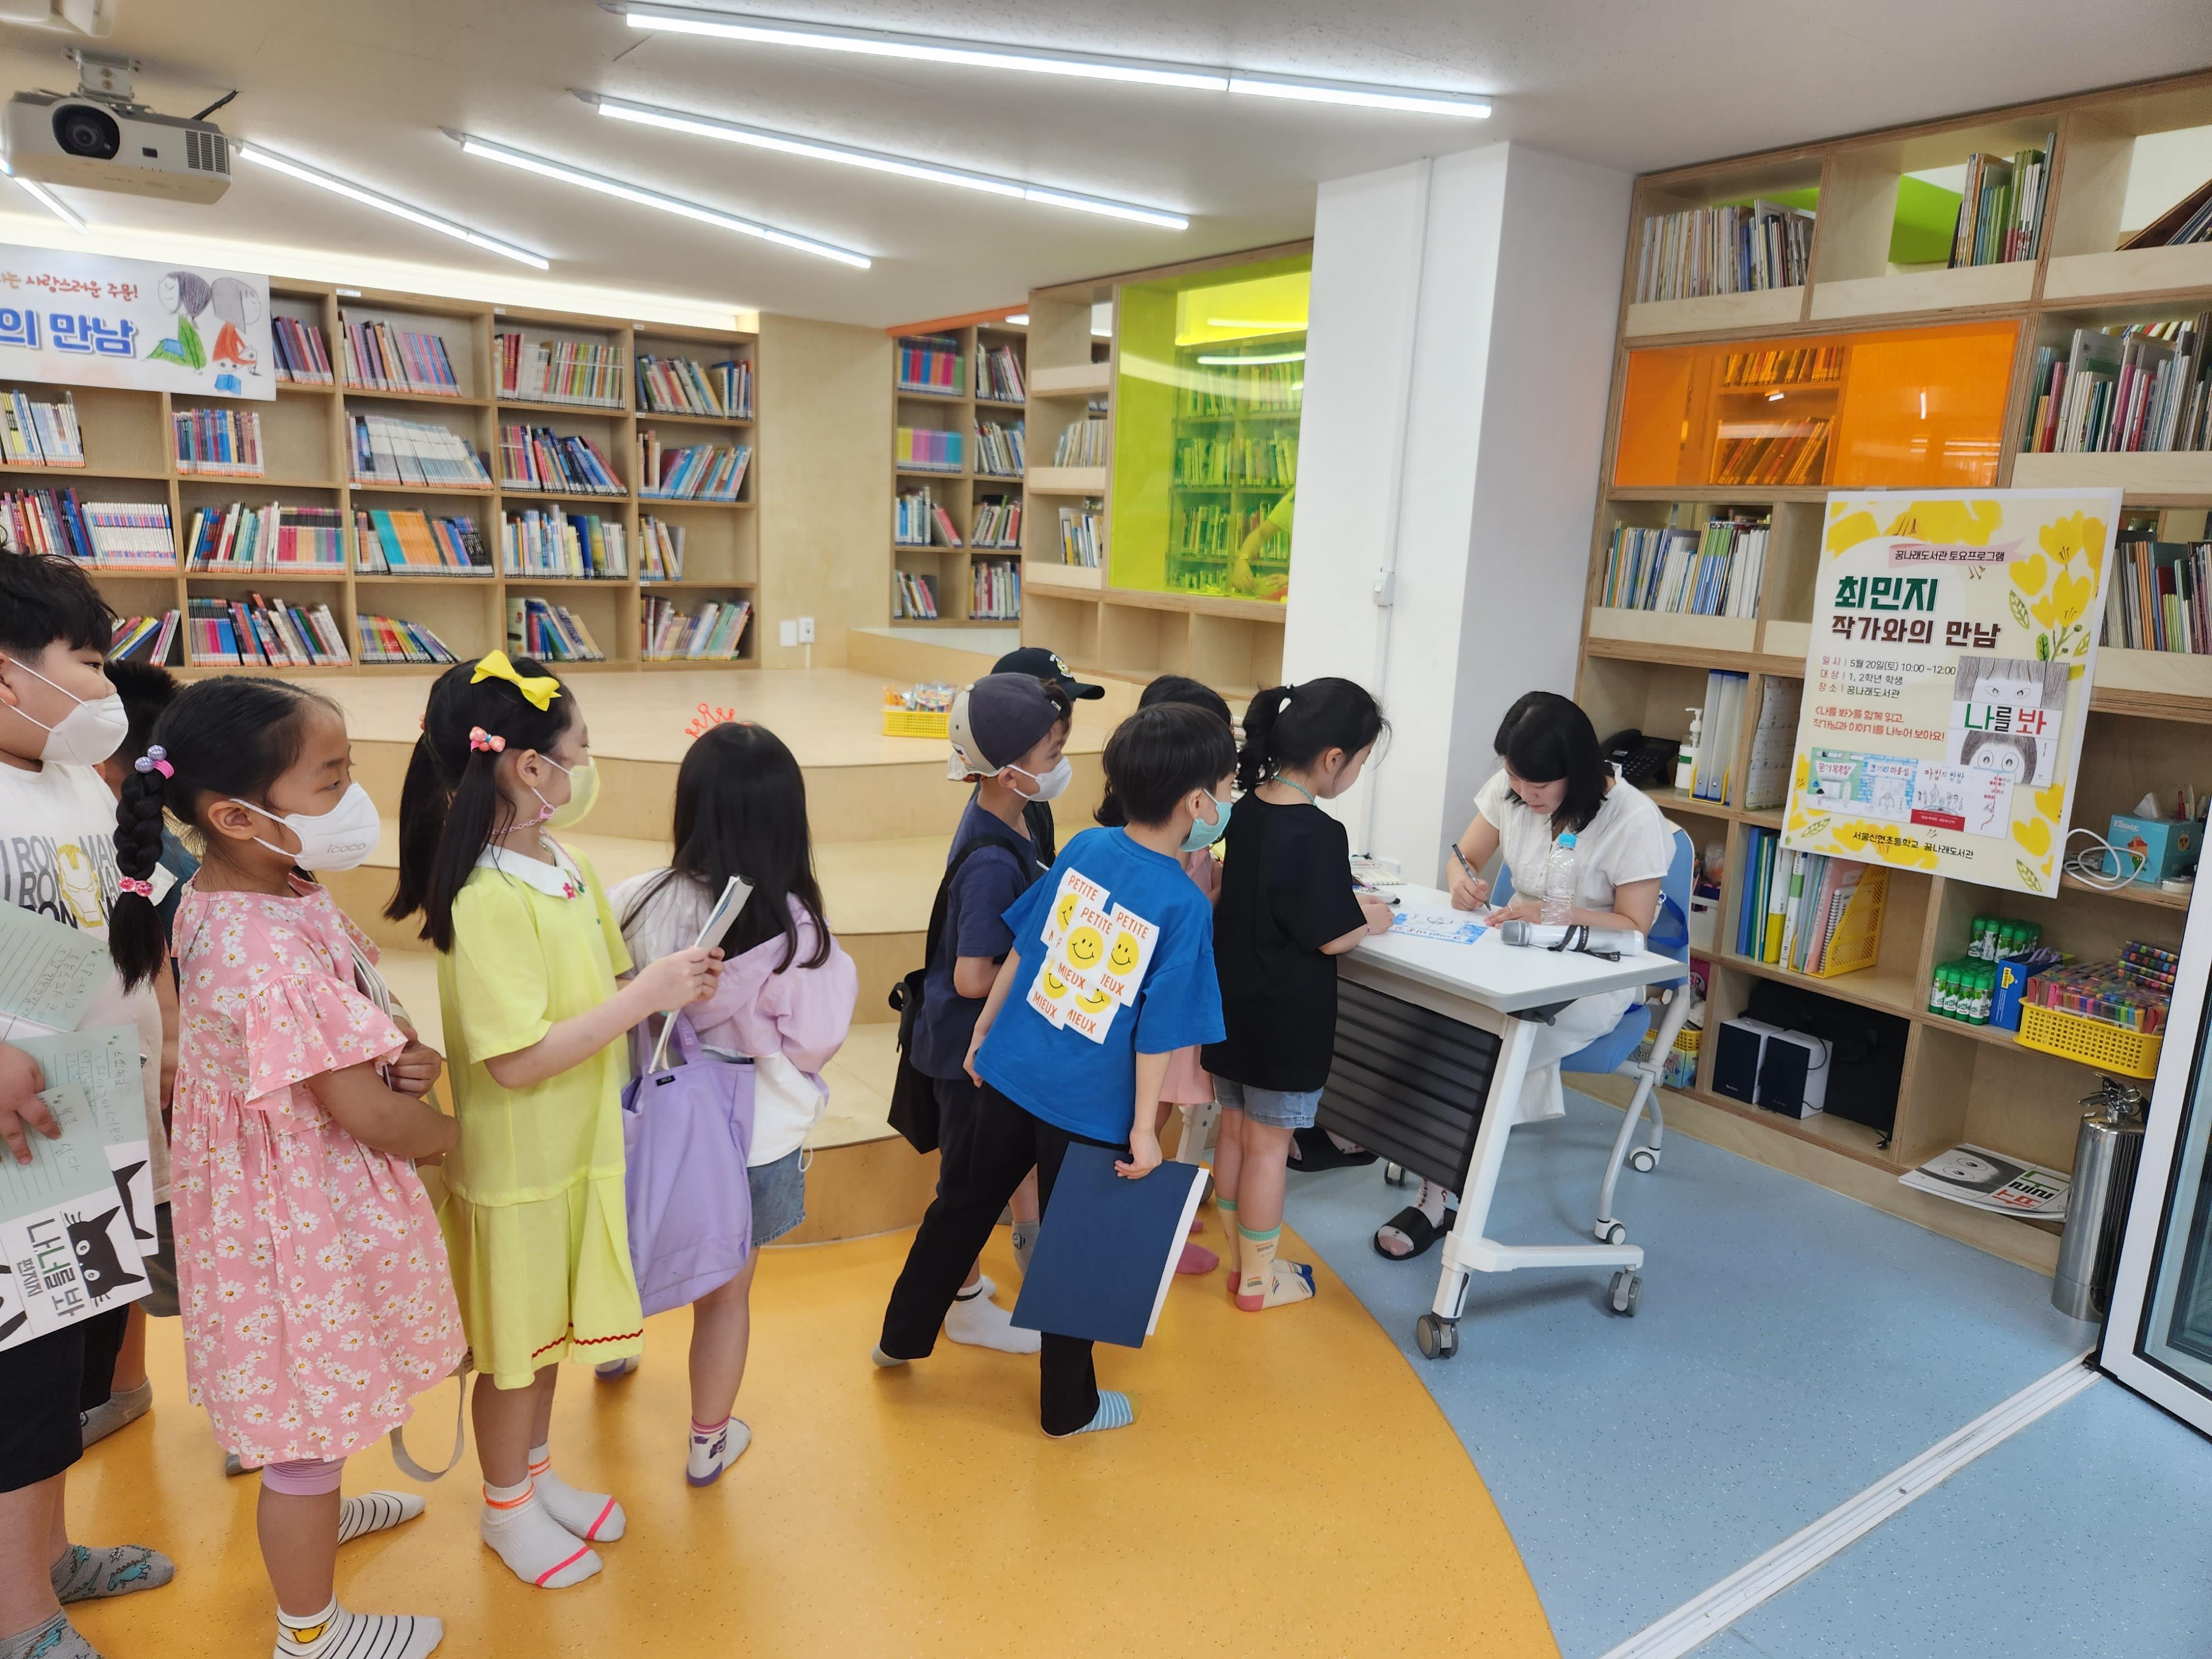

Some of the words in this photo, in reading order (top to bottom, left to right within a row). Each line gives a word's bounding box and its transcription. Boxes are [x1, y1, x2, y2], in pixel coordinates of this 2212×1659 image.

[25, 274, 101, 298] 사랑스러운
[107, 283, 138, 301] 주문!
[49, 312, 134, 354] 만남
[1895, 550, 1948, 561] 꿈나래도서관
[1949, 551, 2005, 562] 토요프로그램
[1835, 576, 1938, 612] 최민지
[1832, 615, 1934, 644] 작가와의
[1945, 621, 2001, 649] 만남
[1850, 659, 1864, 669] 5월
[1865, 661, 1898, 672] 20일(토)
[1902, 663, 1924, 673] 10:00
[1859, 673, 1882, 684] 2학년
[1885, 675, 1903, 686] 학생
[1846, 685, 1900, 699] 꿈나래도서관
[1864, 710, 1882, 721] 함께
[1964, 703, 2012, 733] 나를
[2016, 708, 2047, 735] 봐
[1813, 718, 1847, 732] 작가님과
[1849, 722, 1884, 735] 이야기를
[1886, 726, 1913, 738] 나누어
[1913, 729, 1945, 742] 보아요!
[327, 843, 366, 854] icoco
[1853, 831, 1919, 849] 서울신현초등학교
[1923, 842, 1974, 860] 꿈나래도서관
[1068, 875, 1099, 901] PETITE
[1080, 906, 1113, 935] PETITE
[1116, 911, 1149, 940] PETITE
[1057, 962, 1086, 990] MIEUX
[1032, 992, 1058, 1019] MIEUX
[1992, 1189, 2042, 1208] 봐
[2008, 1170, 2070, 1200] 나를
[16, 1257, 44, 1298] 편지지
[51, 1287, 85, 1317] 봐
